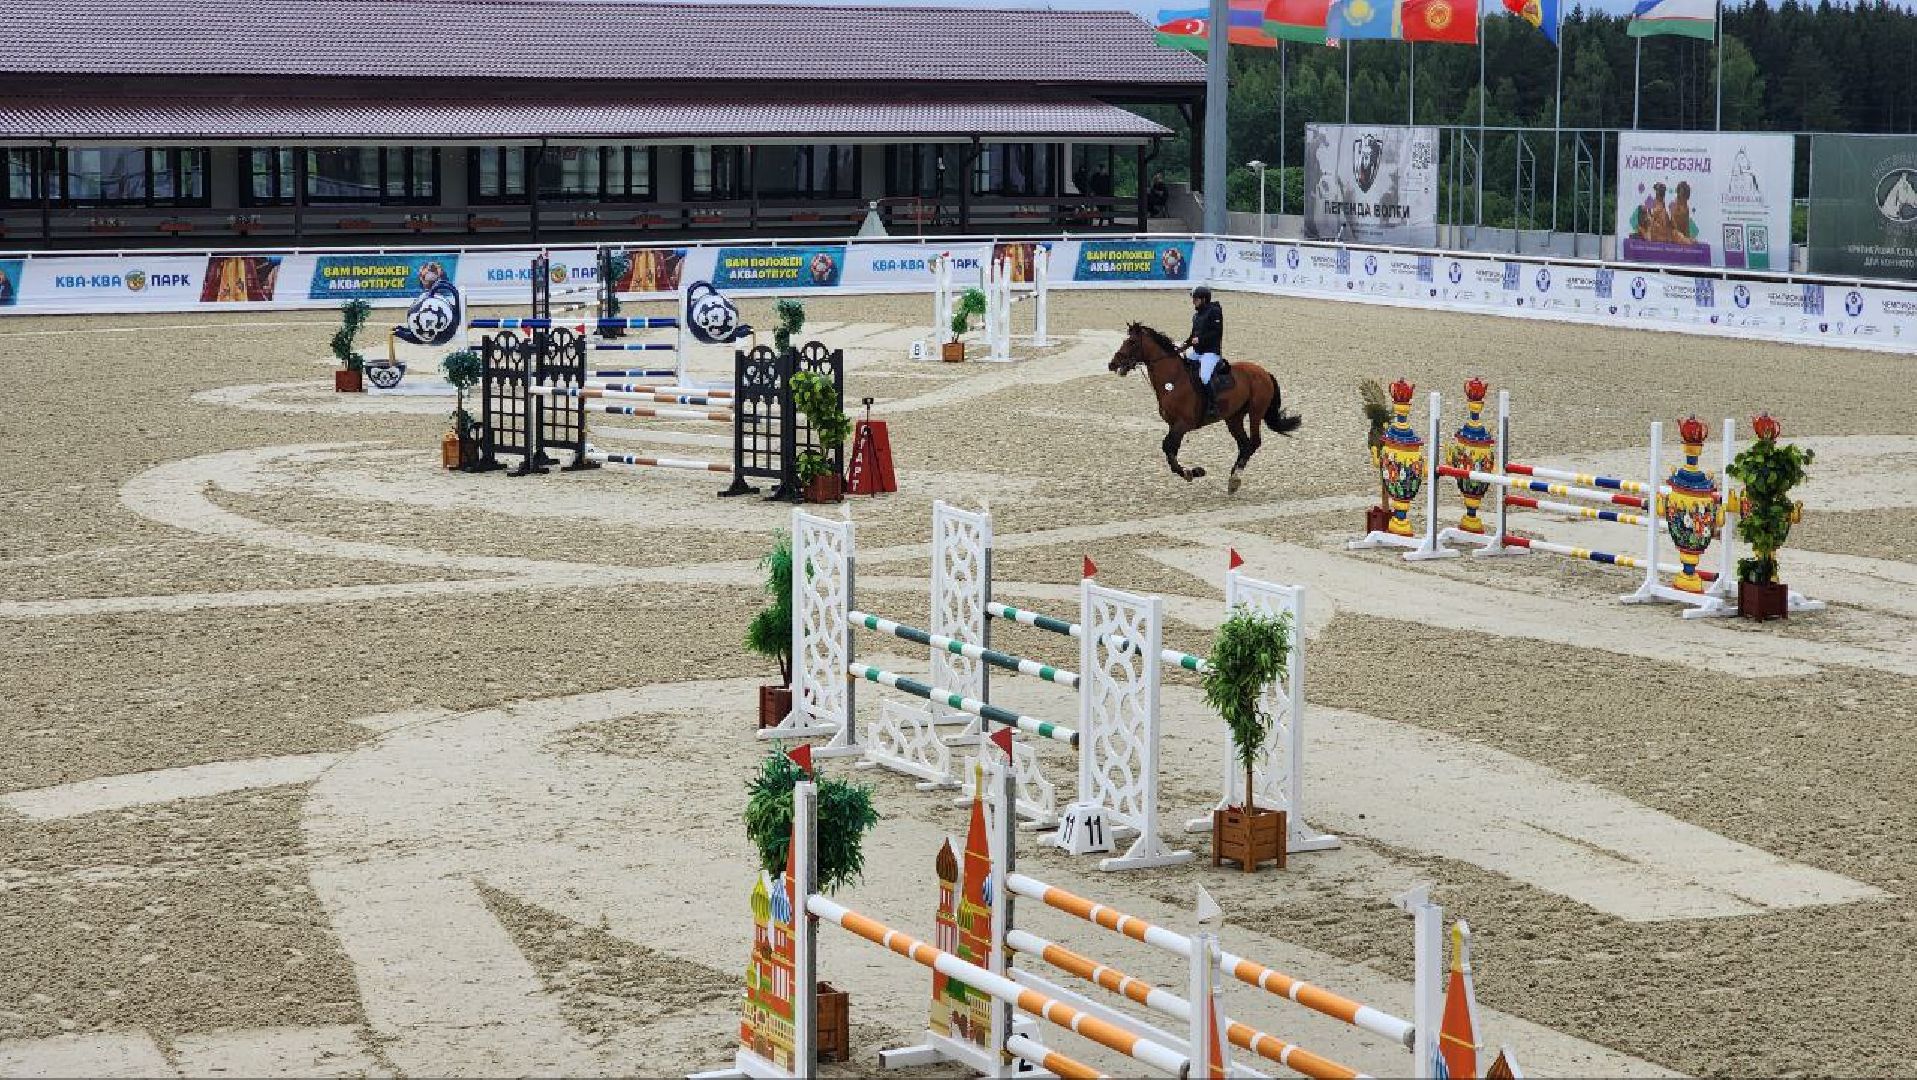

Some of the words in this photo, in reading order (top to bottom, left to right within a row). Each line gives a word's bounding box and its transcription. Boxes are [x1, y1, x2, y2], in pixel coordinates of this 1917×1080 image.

[1625, 154, 1711, 173] ХАРПЕРСБЭНД
[726, 257, 749, 268] ВАМ
[872, 259, 925, 271] КВА-КВА
[323, 266, 351, 277] ВАМ
[729, 268, 799, 279] АКВАОТПУСК
[55, 274, 122, 288] КВА-КВА
[151, 273, 191, 287] ПАРК
[329, 277, 405, 290] АКВАОТПУСК
[1084, 815, 1103, 847] 11
